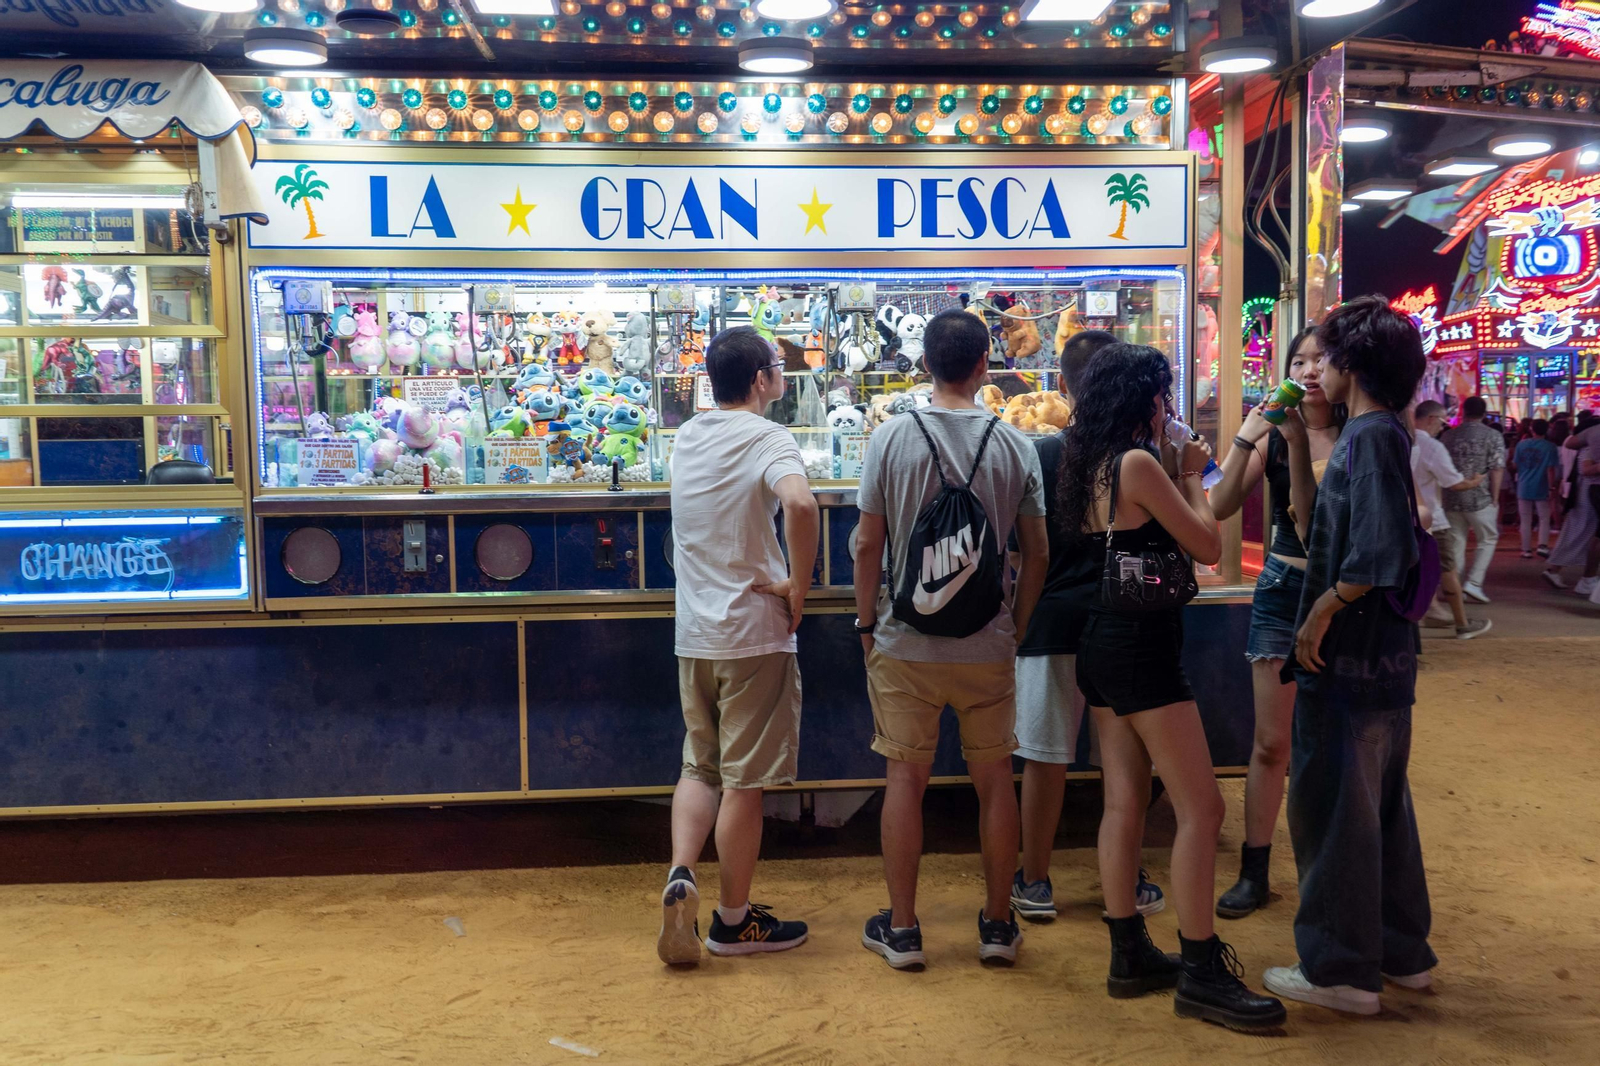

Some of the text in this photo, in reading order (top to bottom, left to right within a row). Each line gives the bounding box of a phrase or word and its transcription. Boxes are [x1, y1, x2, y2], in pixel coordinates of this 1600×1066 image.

[369, 174, 1072, 240] LA GRAN PESCA
[100, 216, 133, 228] VENDEN
[323, 449, 354, 459] PARTIDA
[510, 448, 540, 457] PARTIDA
[321, 459, 357, 469] PARTIDAS
[508, 458, 542, 467] PARTIDAS
